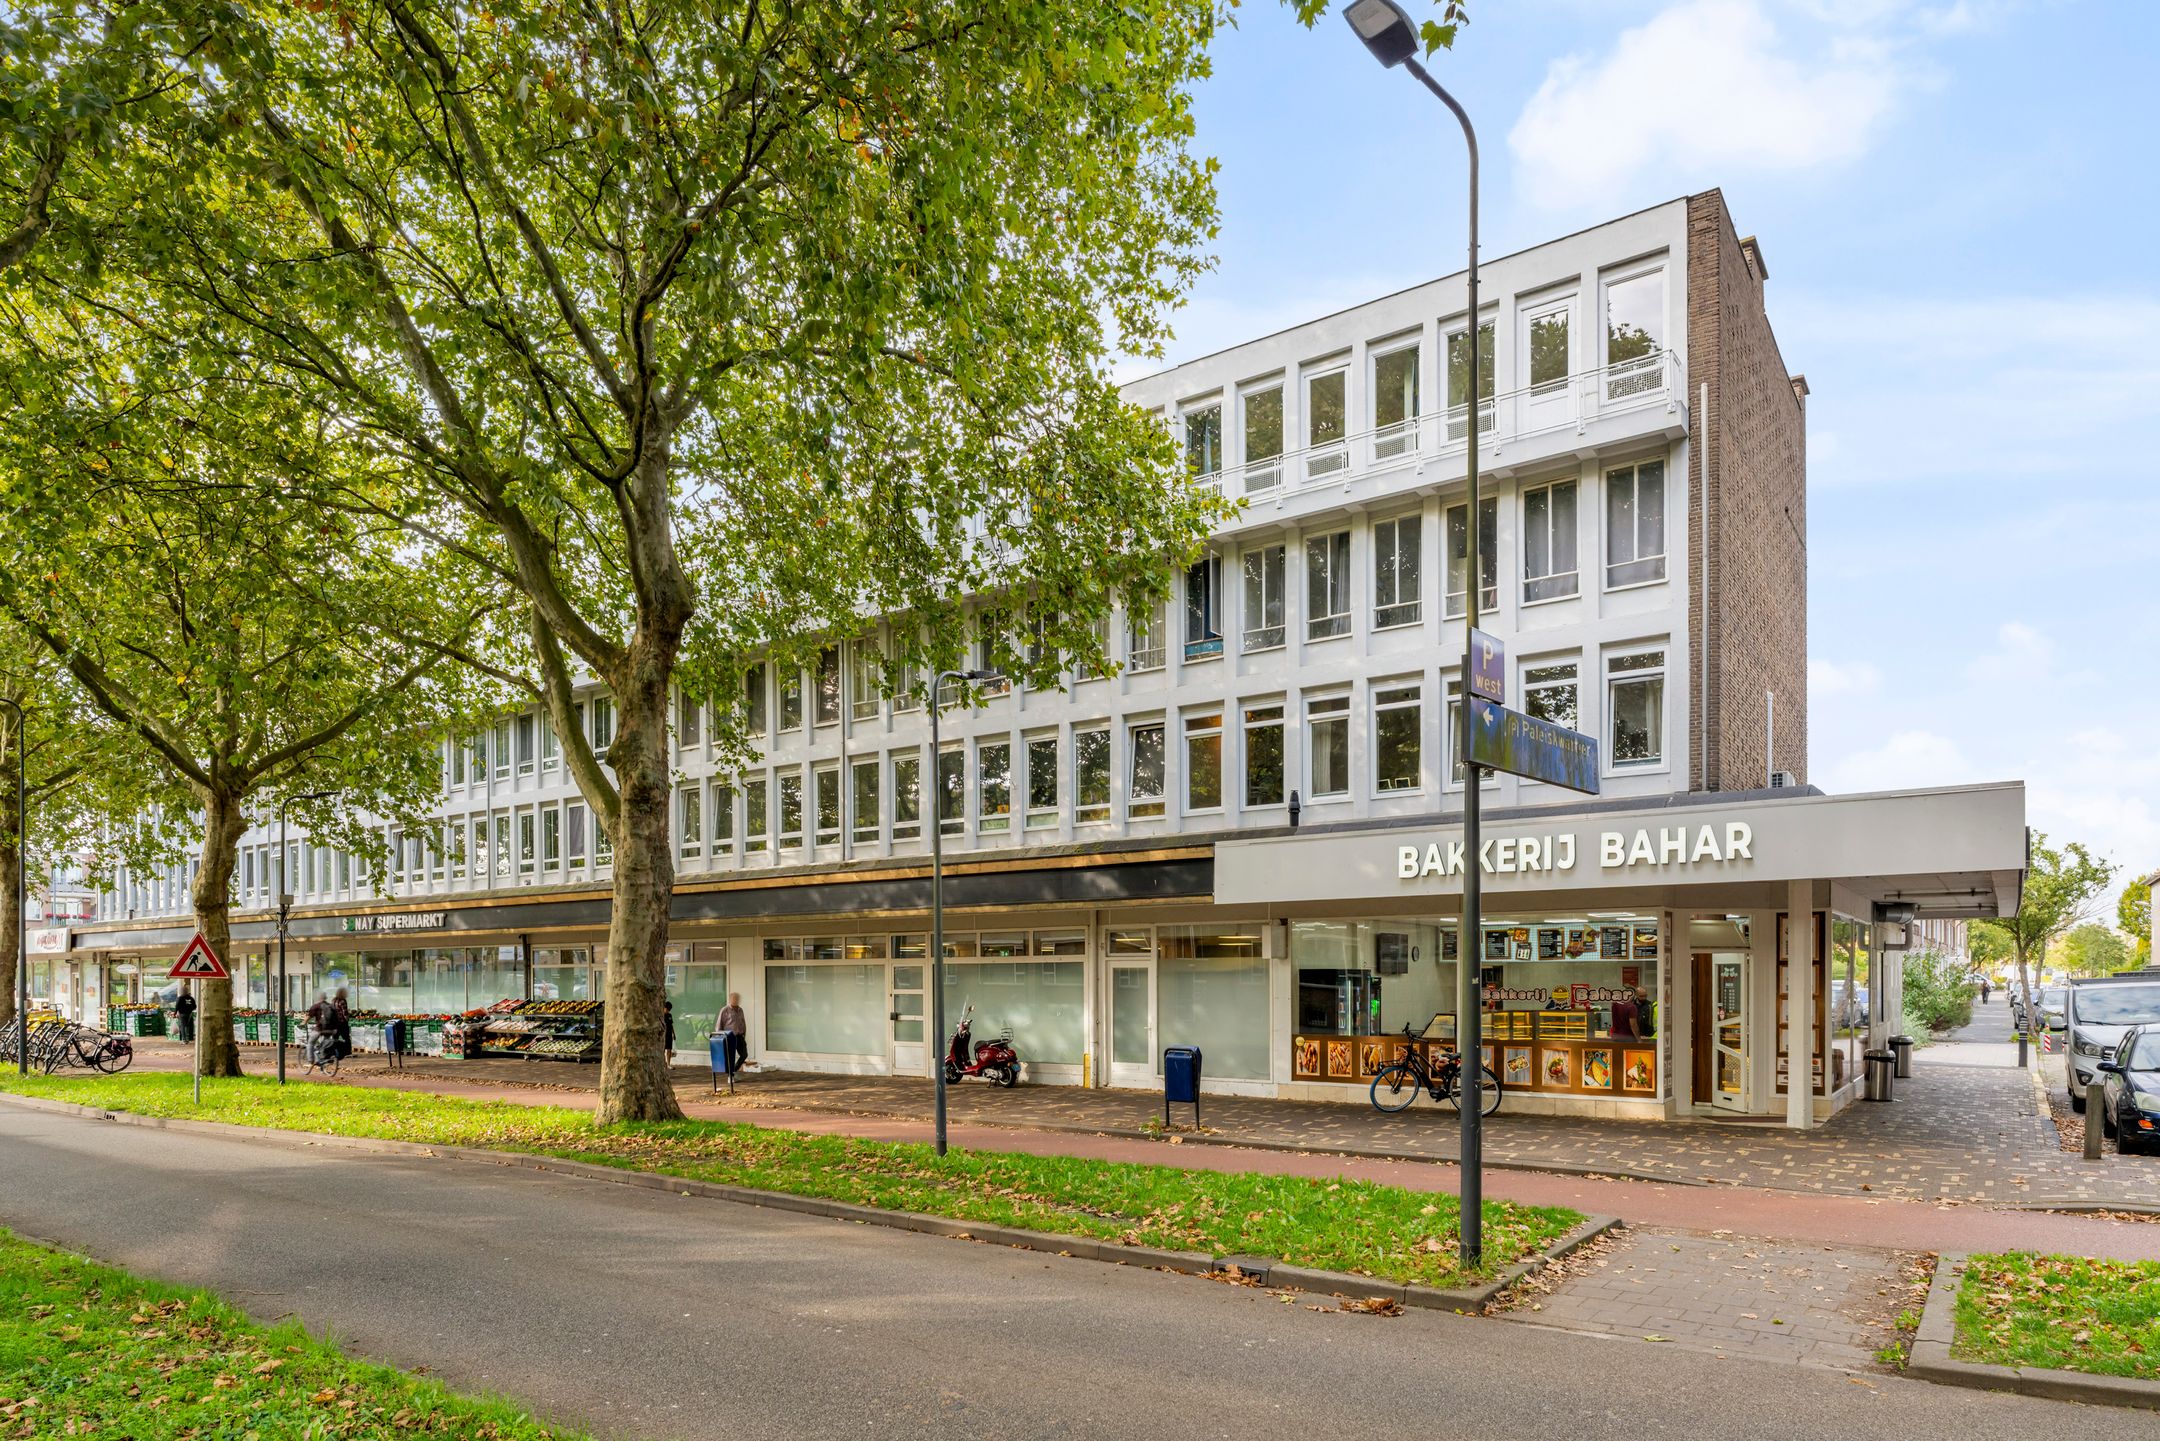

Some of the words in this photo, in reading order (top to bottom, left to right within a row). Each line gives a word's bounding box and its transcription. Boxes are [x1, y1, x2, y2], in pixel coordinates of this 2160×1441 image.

[1483, 640, 1494, 670] P
[1475, 674, 1501, 695] west
[1398, 834, 1576, 879] BAKKERIJ
[1600, 822, 1753, 869] BAHAR
[376, 912, 443, 929] SUPERMARKT
[1482, 987, 1547, 1003] Bakkerij
[1575, 986, 1635, 1002] Bahar
